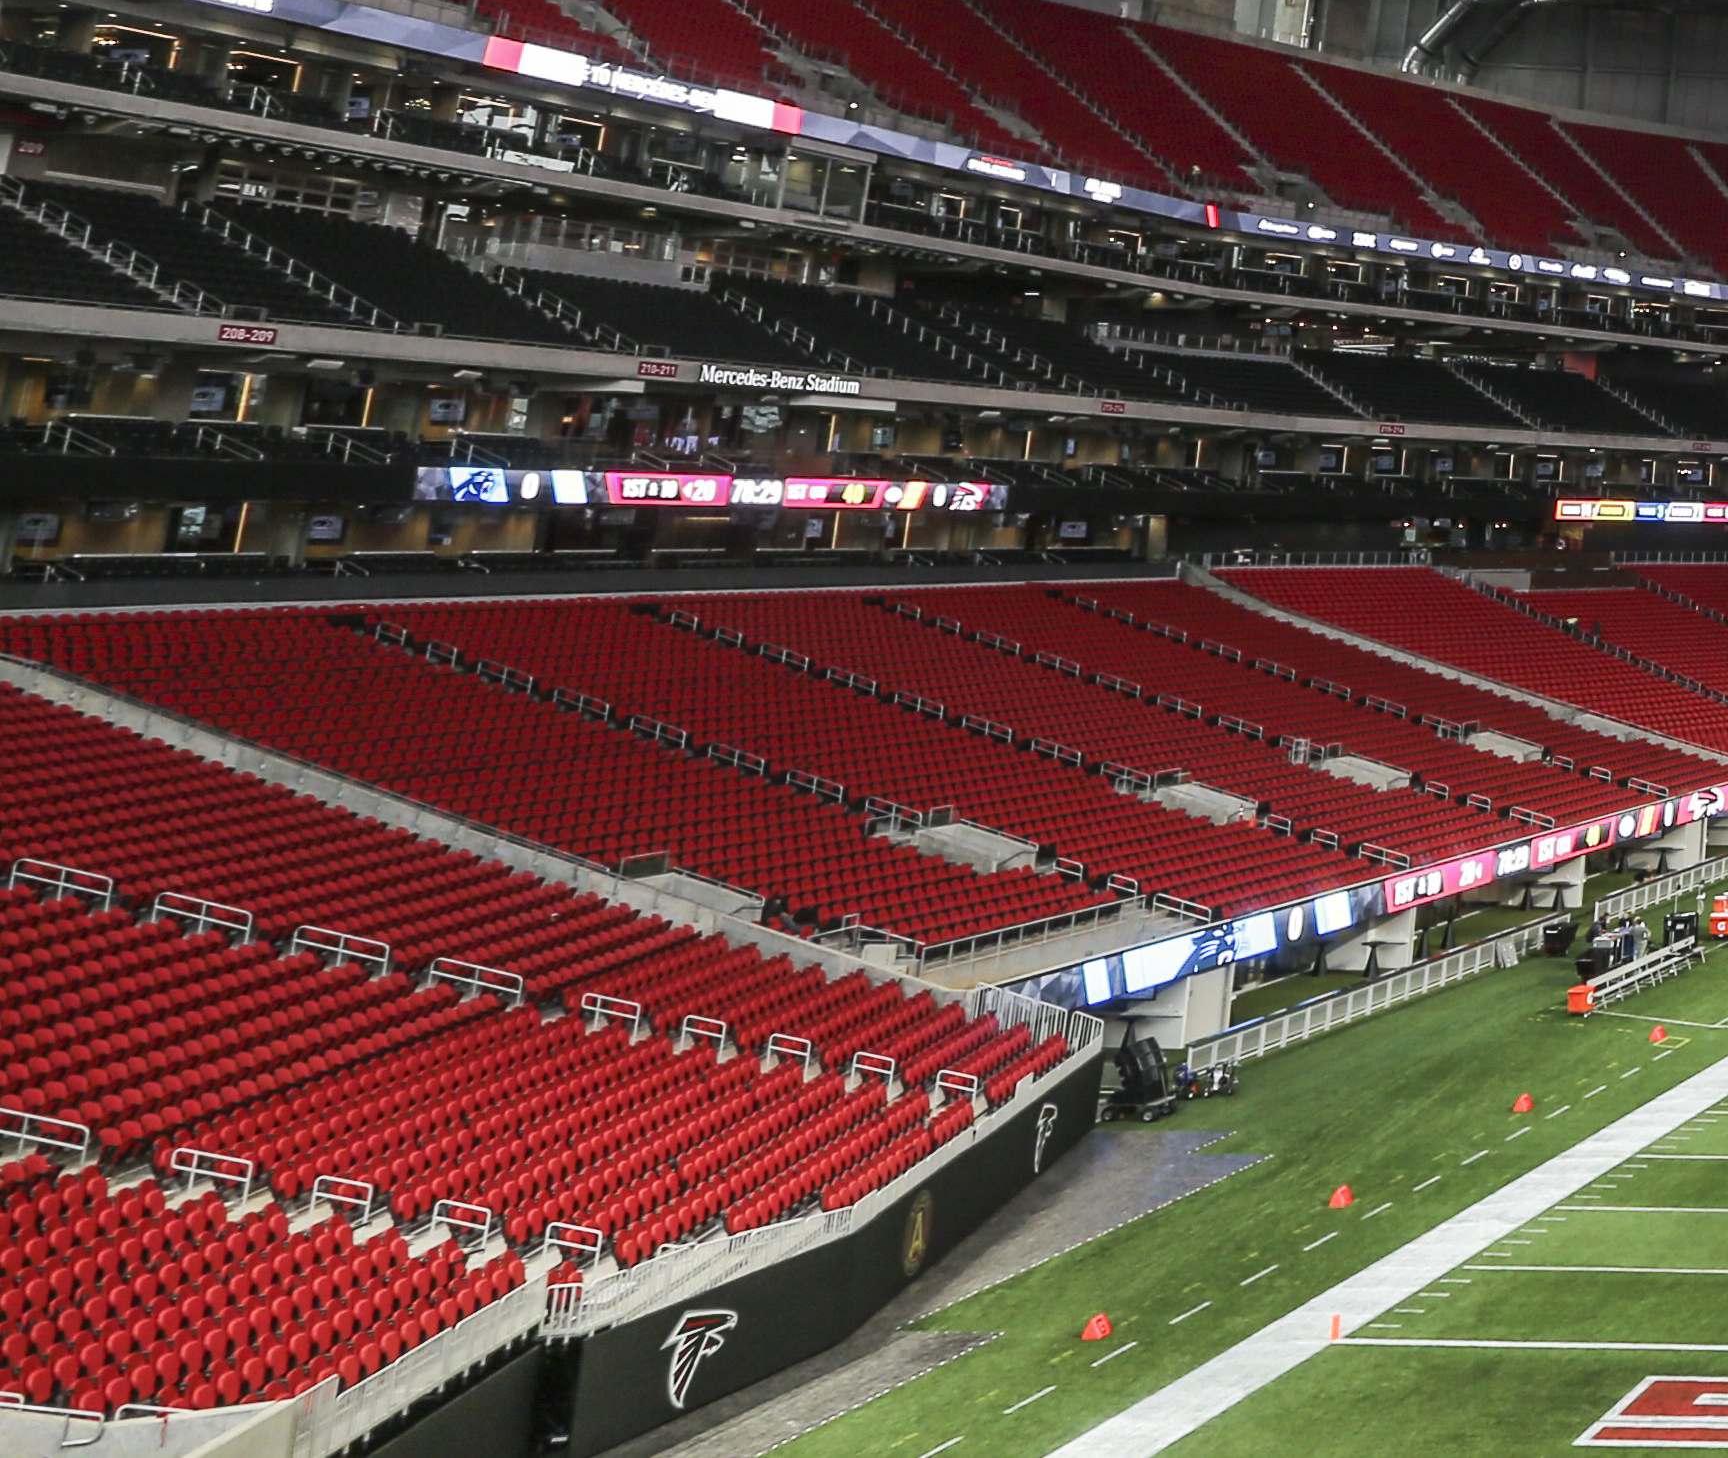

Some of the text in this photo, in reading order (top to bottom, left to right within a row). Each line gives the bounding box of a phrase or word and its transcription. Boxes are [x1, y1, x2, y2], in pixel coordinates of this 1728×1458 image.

[221, 327, 275, 342] 208-209
[699, 364, 861, 395] Mercedes-Benz Stadium
[520, 472, 540, 500] 0
[621, 477, 646, 499] 1ST
[660, 479, 679, 499] 10
[692, 480, 717, 503] 20
[731, 478, 783, 505] 78:29
[842, 483, 865, 505] 40
[1286, 905, 1304, 942] 0
